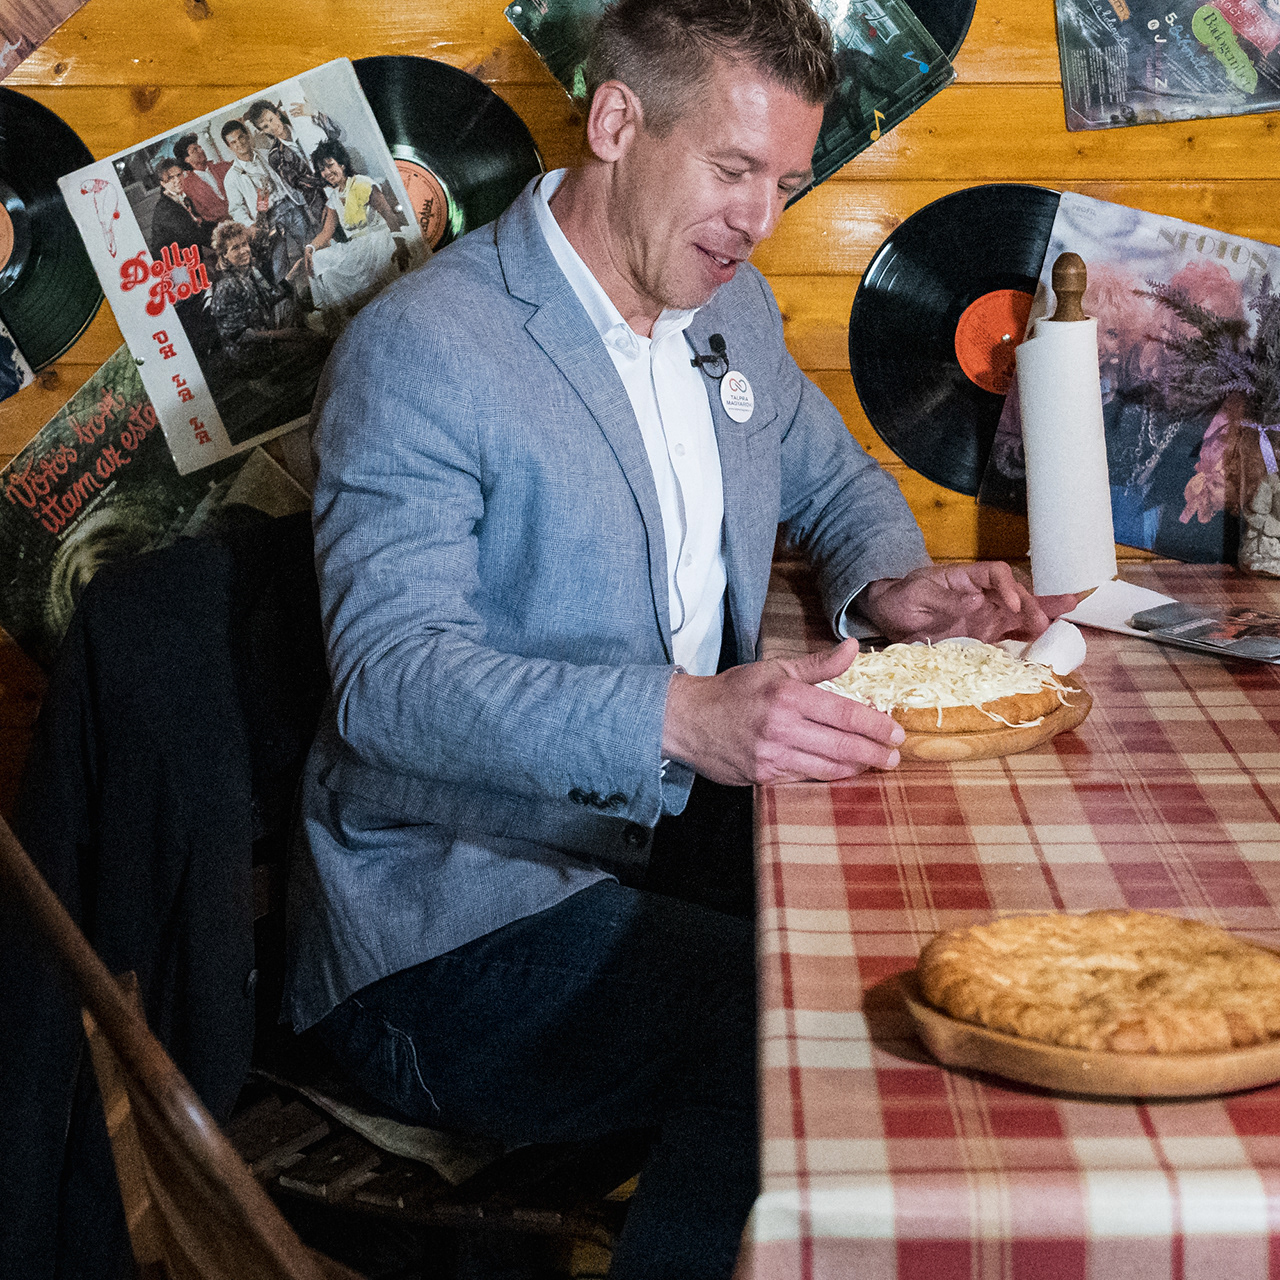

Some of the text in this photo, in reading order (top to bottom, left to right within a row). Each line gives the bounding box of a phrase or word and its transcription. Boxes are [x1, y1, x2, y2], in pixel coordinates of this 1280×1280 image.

[120, 242, 201, 294] Dolly
[146, 268, 211, 316] Roll
[152, 330, 176, 359] OH
[173, 375, 195, 402] LA
[6, 444, 77, 508] Vörös
[69, 388, 125, 444] bort
[190, 418, 212, 445] LA
[34, 472, 103, 533] ittam
[96, 445, 131, 478] az
